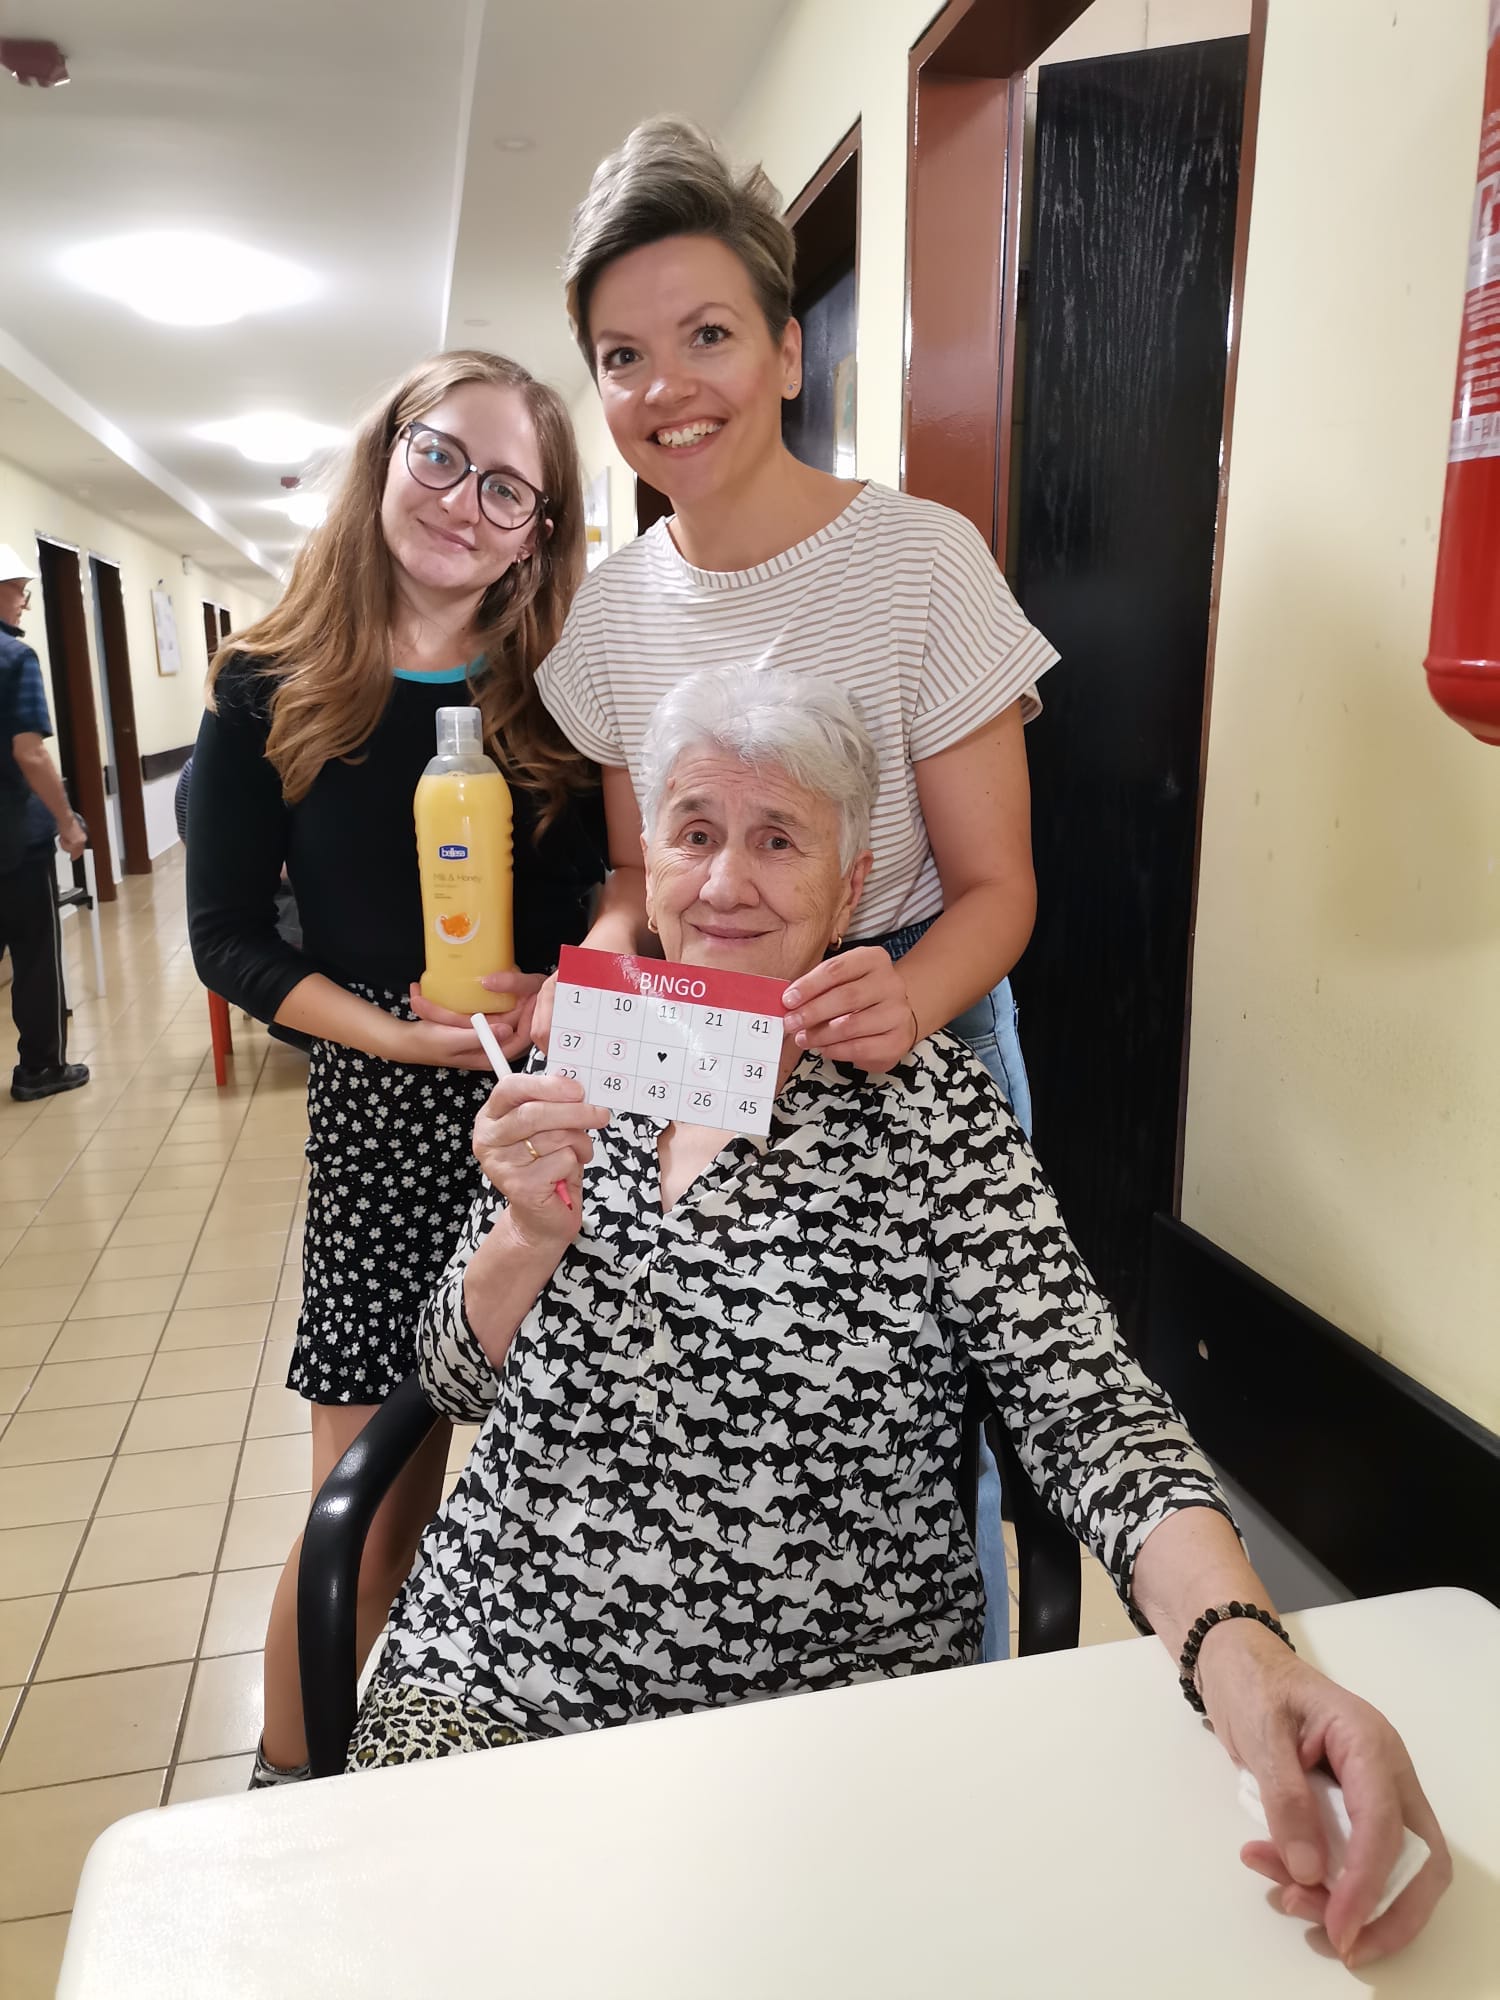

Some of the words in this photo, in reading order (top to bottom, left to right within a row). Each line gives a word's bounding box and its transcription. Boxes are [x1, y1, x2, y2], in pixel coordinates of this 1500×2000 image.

[457, 873, 482, 884] Honey
[639, 972, 706, 998] BINGO
[573, 991, 582, 1004] 1
[614, 998, 632, 1012] 10
[659, 1005, 677, 1019] 11
[705, 1012, 723, 1027] 21
[751, 1020, 769, 1034] 41
[563, 1034, 582, 1049] 37
[612, 1043, 621, 1056] 3
[699, 1057, 718, 1072] 17
[743, 1064, 763, 1079] 34
[603, 1076, 622, 1091] 48
[648, 1085, 666, 1099] 43
[693, 1092, 712, 1107] 26
[738, 1100, 757, 1115] 45
